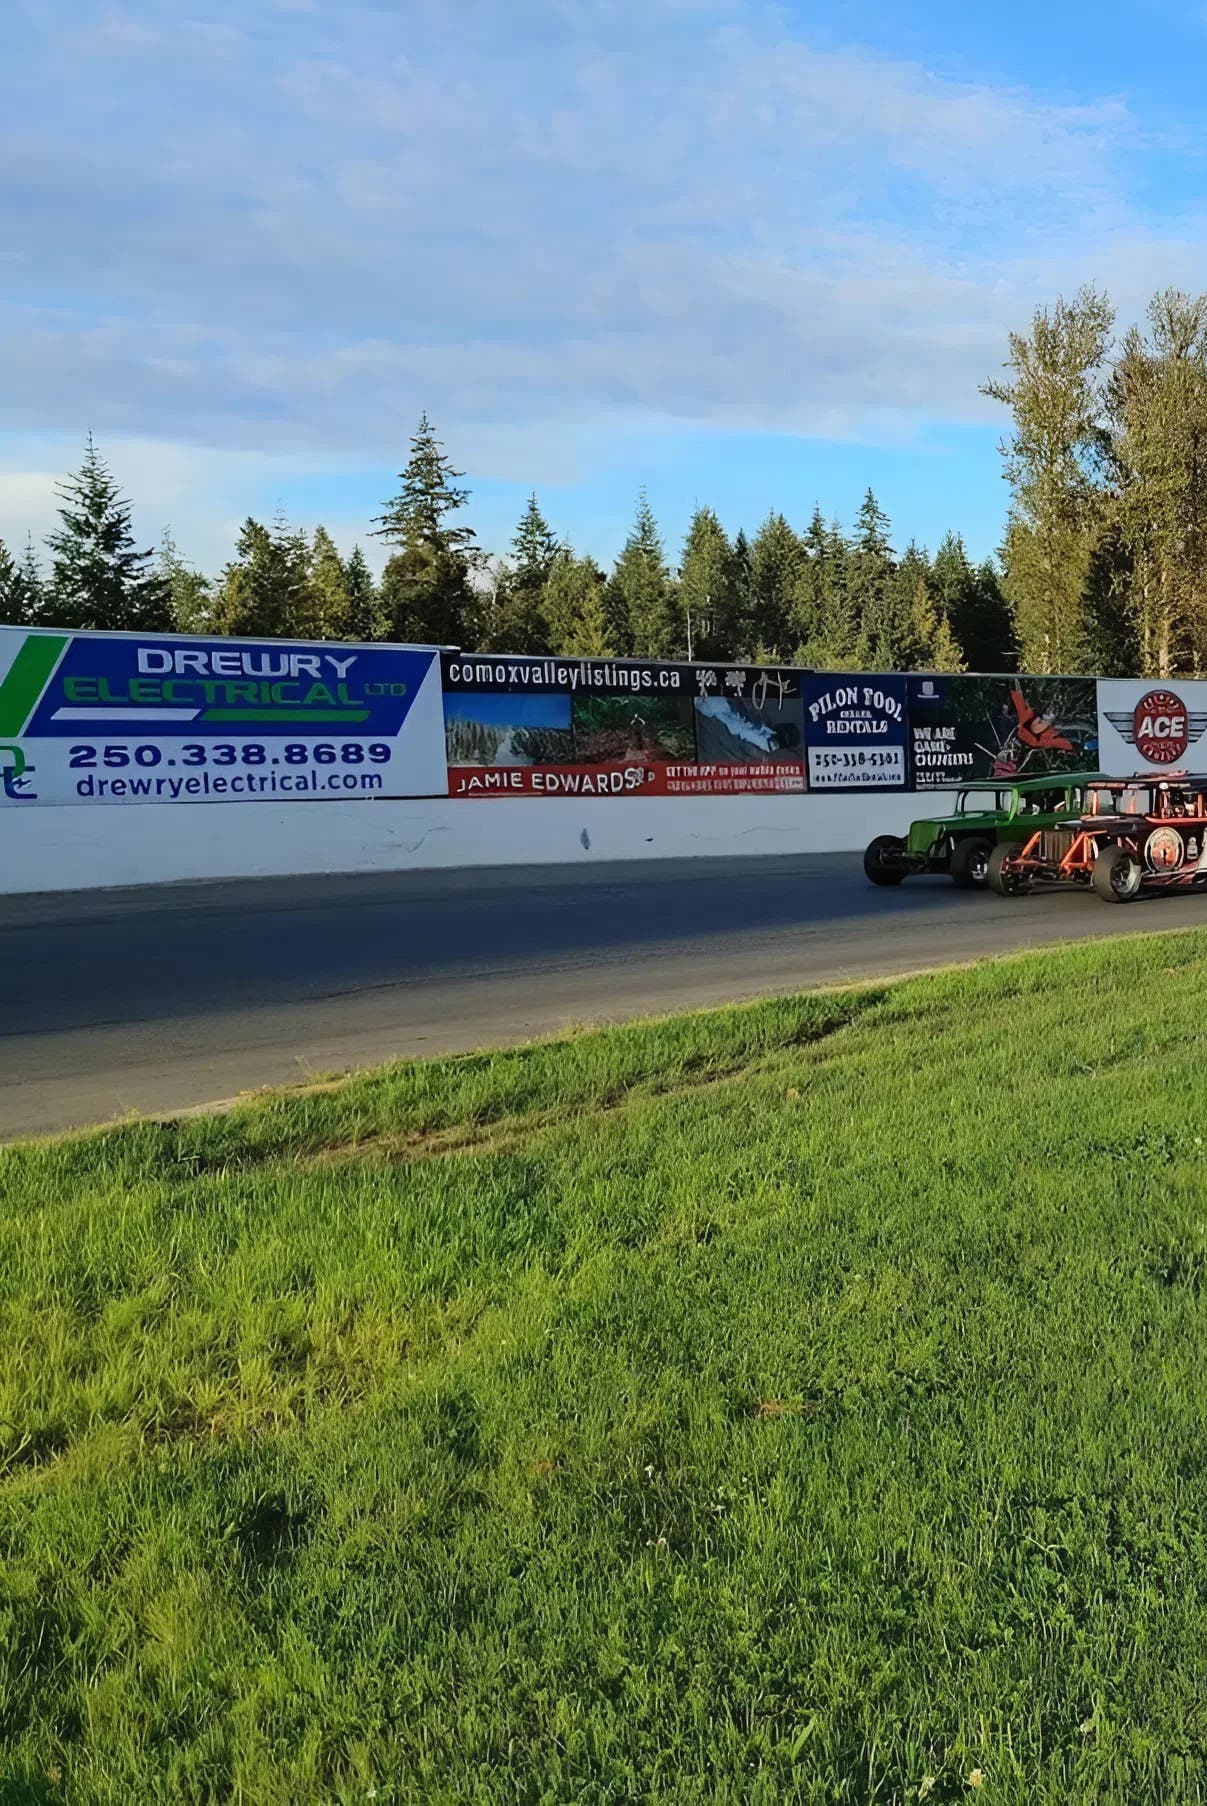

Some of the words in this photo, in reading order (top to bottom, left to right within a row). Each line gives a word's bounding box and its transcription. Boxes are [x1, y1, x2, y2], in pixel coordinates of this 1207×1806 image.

[138, 648, 358, 679] DREWRY
[450, 661, 681, 690] comoxvalleylistings.ca
[63, 677, 364, 705] ELECTRICAL
[365, 683, 406, 697] LTD
[1137, 715, 1185, 739] ACE
[69, 743, 392, 768] 250.338.8689
[76, 770, 383, 798] drewryelectrical.com
[457, 772, 524, 792] JAMIE
[531, 768, 638, 793] EDWARDS
